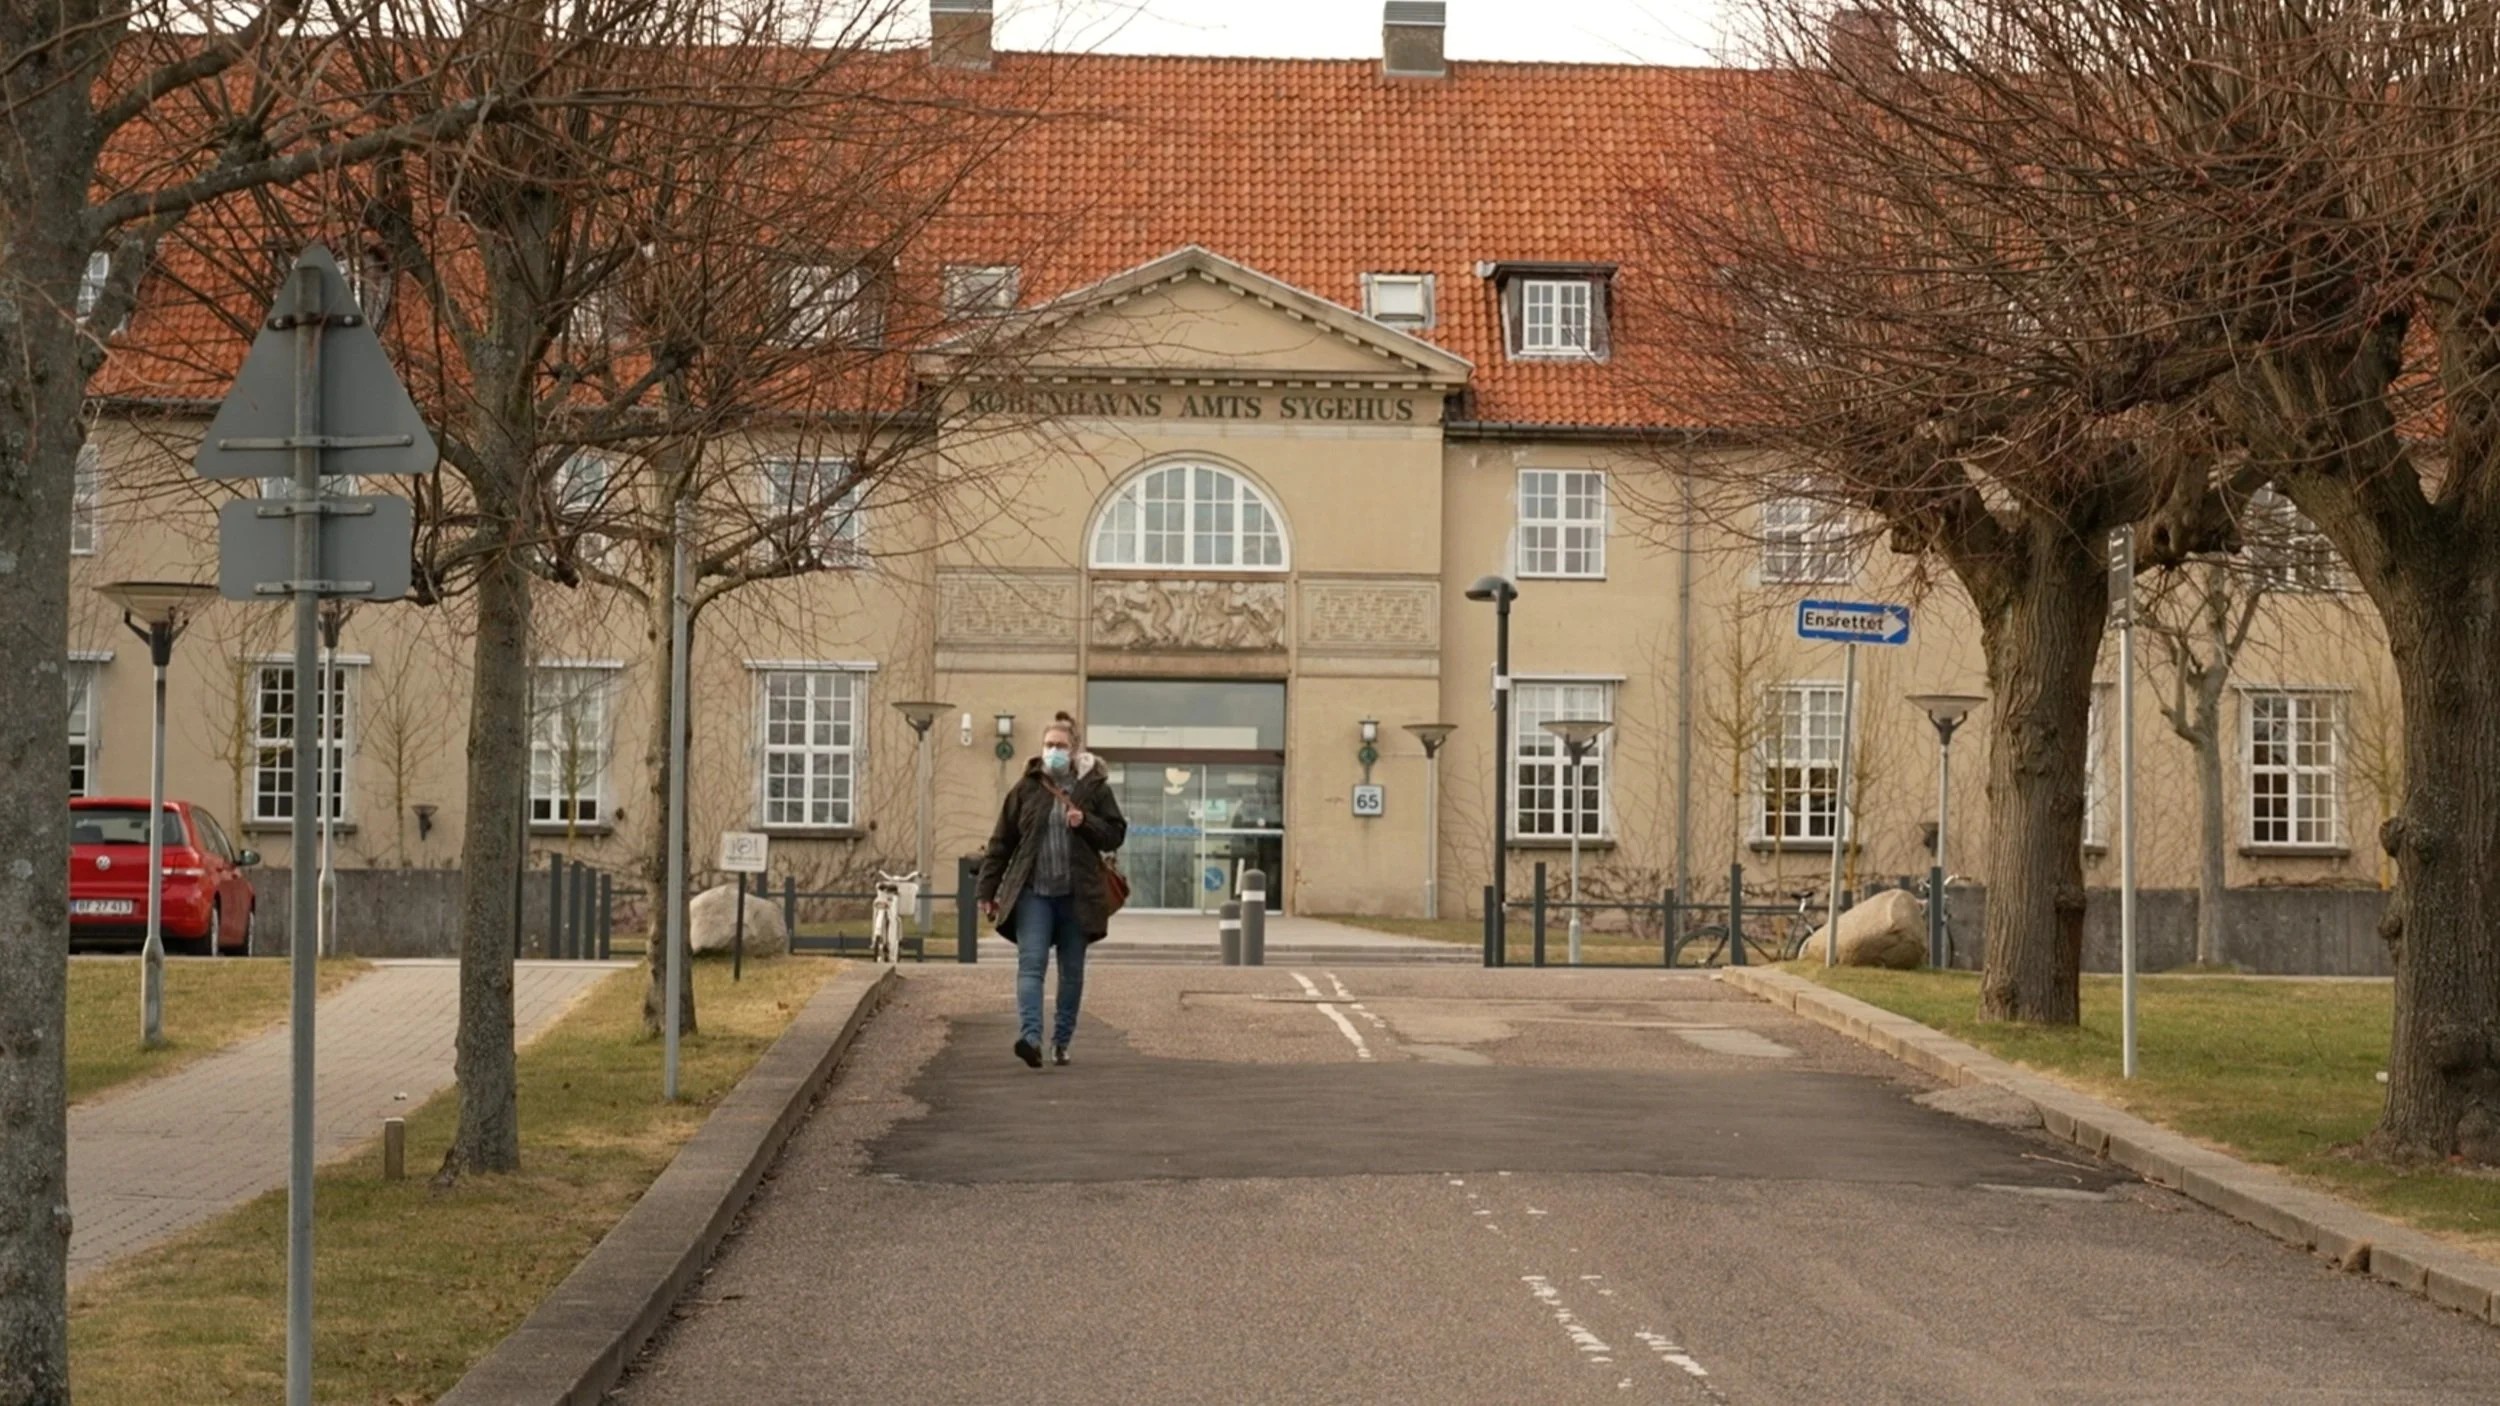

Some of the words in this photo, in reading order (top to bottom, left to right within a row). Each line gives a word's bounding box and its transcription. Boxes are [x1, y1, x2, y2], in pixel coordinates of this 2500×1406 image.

[1178, 395, 1262, 419] AMTS
[1279, 396, 1413, 421] SYGEHUS
[1804, 611, 1883, 630] Ensrettet
[1356, 794, 1379, 810] 65
